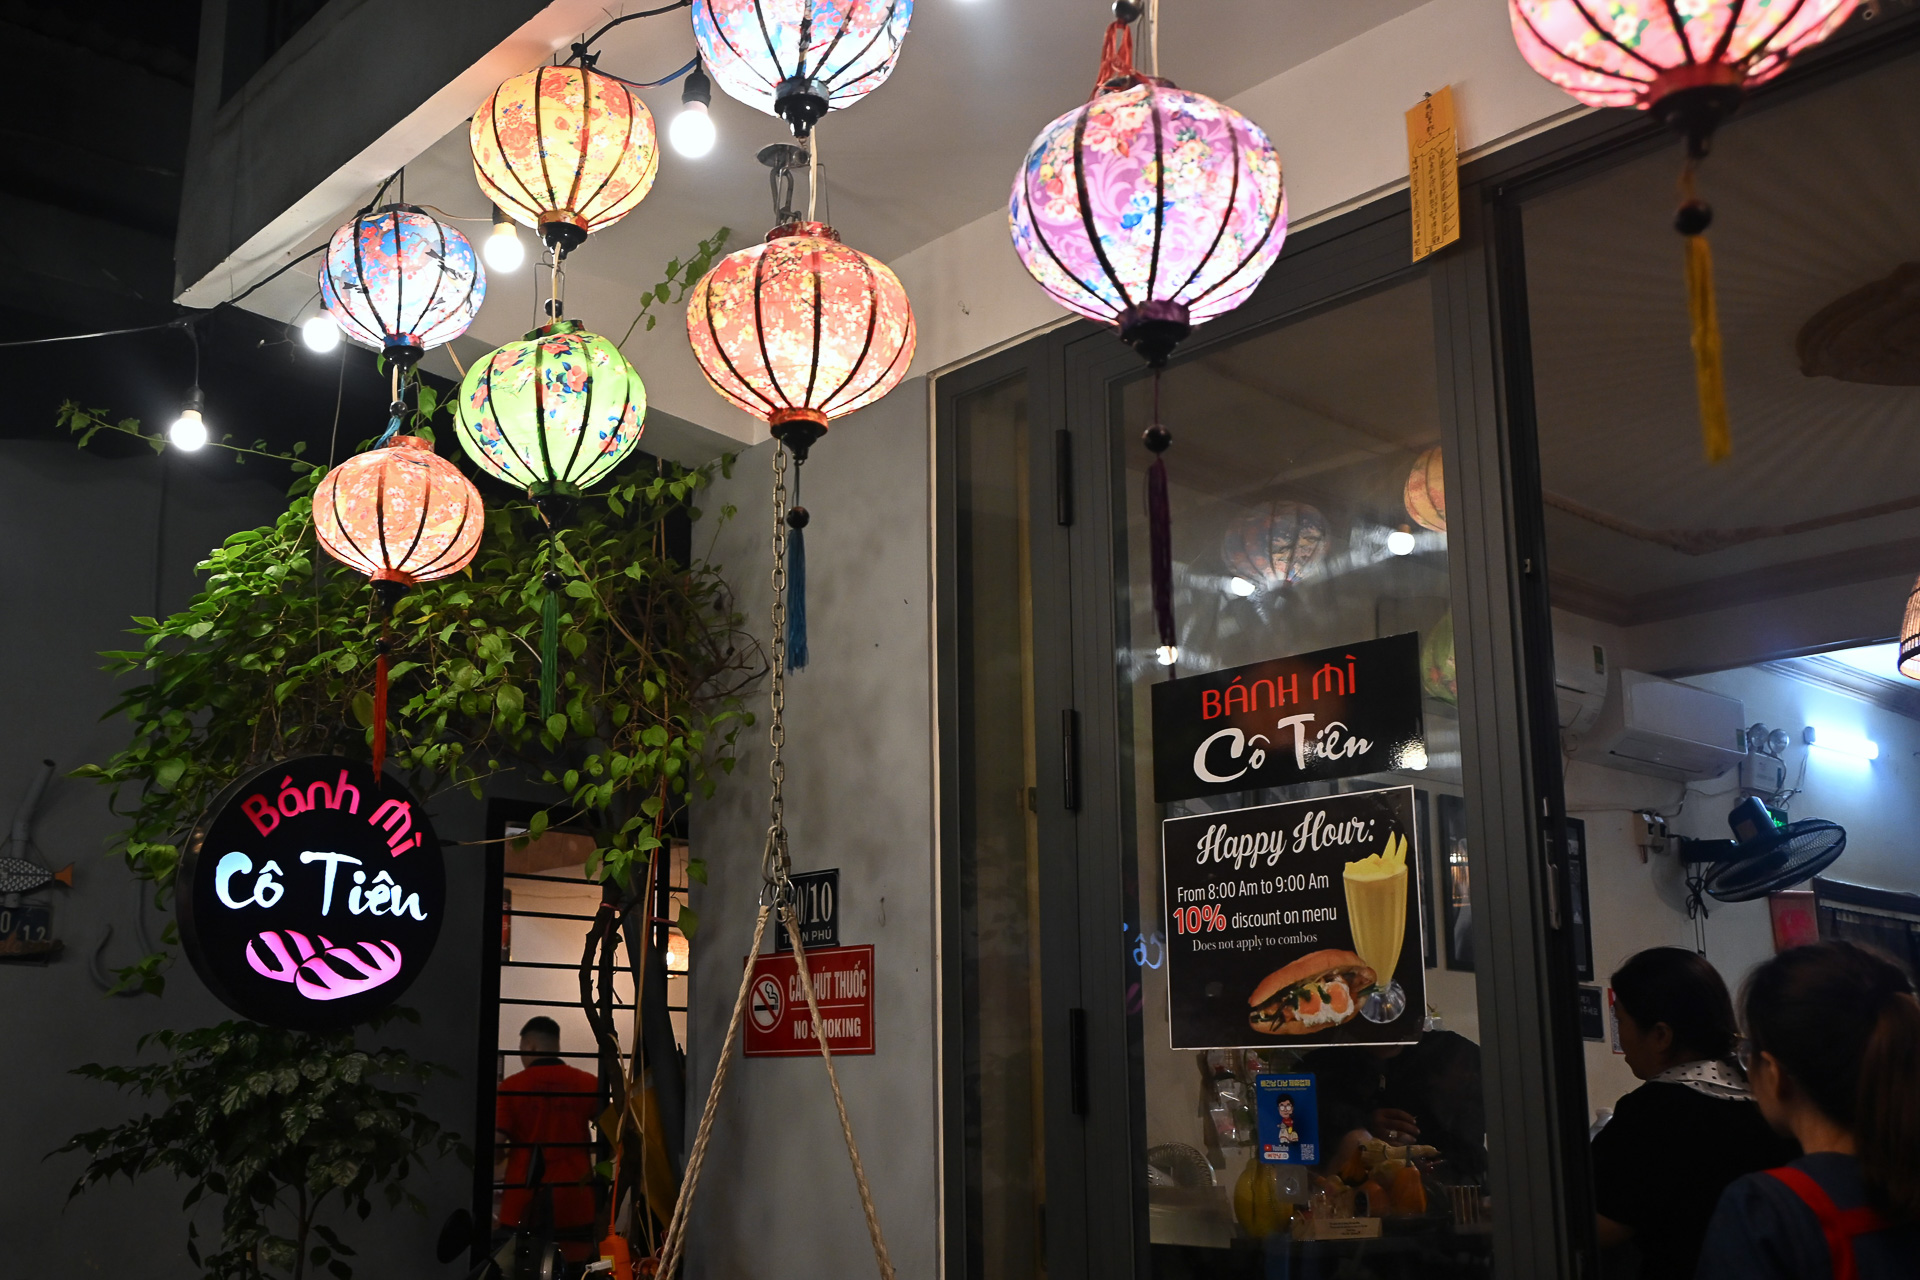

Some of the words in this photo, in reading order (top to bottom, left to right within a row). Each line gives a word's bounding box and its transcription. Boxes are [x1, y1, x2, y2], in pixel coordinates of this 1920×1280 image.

[1193, 727, 1271, 783] Cô
[1277, 713, 1374, 770] Tiên
[240, 769, 360, 838] Bánh
[1196, 823, 1288, 870] Happy
[1292, 810, 1375, 854] Hour:
[215, 851, 285, 909] Cô
[300, 851, 428, 921] Tiên
[1177, 886, 1205, 903] From
[1208, 881, 1236, 900] 8:00
[1239, 880, 1258, 897] Am
[1261, 879, 1273, 895] to
[1275, 874, 1306, 893] 9:00
[1308, 872, 1329, 890] Am
[783, 931, 809, 945] TN
[812, 926, 832, 940] PHÚ
[1172, 903, 1227, 935] 10%
[1231, 909, 1281, 929] discount
[1284, 912, 1300, 925] on
[1302, 907, 1337, 923] menu
[1192, 939, 1217, 952] Does
[1218, 938, 1234, 950] not
[1236, 935, 1264, 951] apply
[1265, 936, 1276, 947] to
[1277, 931, 1318, 946] combos
[813, 966, 832, 1001] HÚT
[834, 960, 866, 999] THUỐC
[794, 1020, 808, 1039] NO
